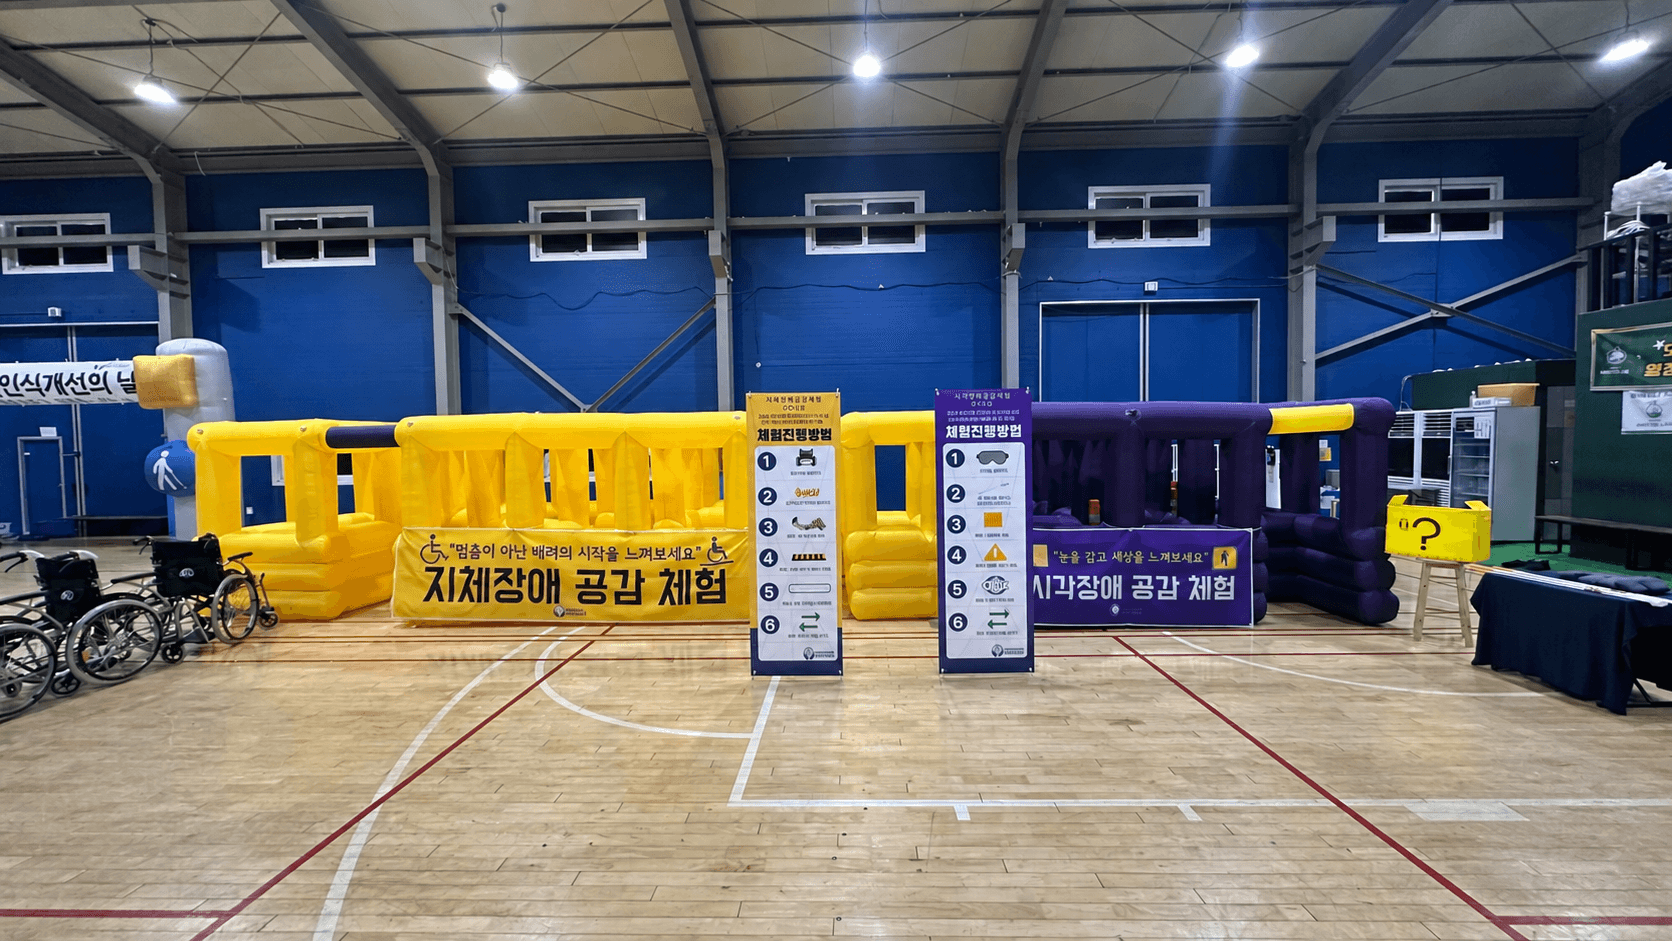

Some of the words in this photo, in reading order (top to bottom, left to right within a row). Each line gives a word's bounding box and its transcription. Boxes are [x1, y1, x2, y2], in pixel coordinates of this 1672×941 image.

[0, 370, 113, 398] 인식개선의
[762, 455, 770, 468] 1
[951, 453, 958, 465] 1
[763, 490, 773, 503] 2
[951, 487, 961, 500] 2
[764, 521, 773, 534] 3
[951, 518, 961, 531] 3
[532, 545, 572, 561] 배려의
[578, 546, 619, 561] 시작을
[763, 551, 773, 564] 4
[951, 548, 962, 562] 4
[1085, 551, 1108, 563] 감고
[423, 565, 560, 604] 지체장애
[575, 568, 645, 605] 공감
[658, 567, 727, 606] 체험
[952, 583, 962, 596] 5
[1033, 575, 1123, 600] 시각장애
[1131, 575, 1180, 600] 공감
[1188, 575, 1236, 600] 체험
[764, 586, 774, 599] 5
[765, 618, 775, 632] 6
[953, 616, 963, 629] 6
